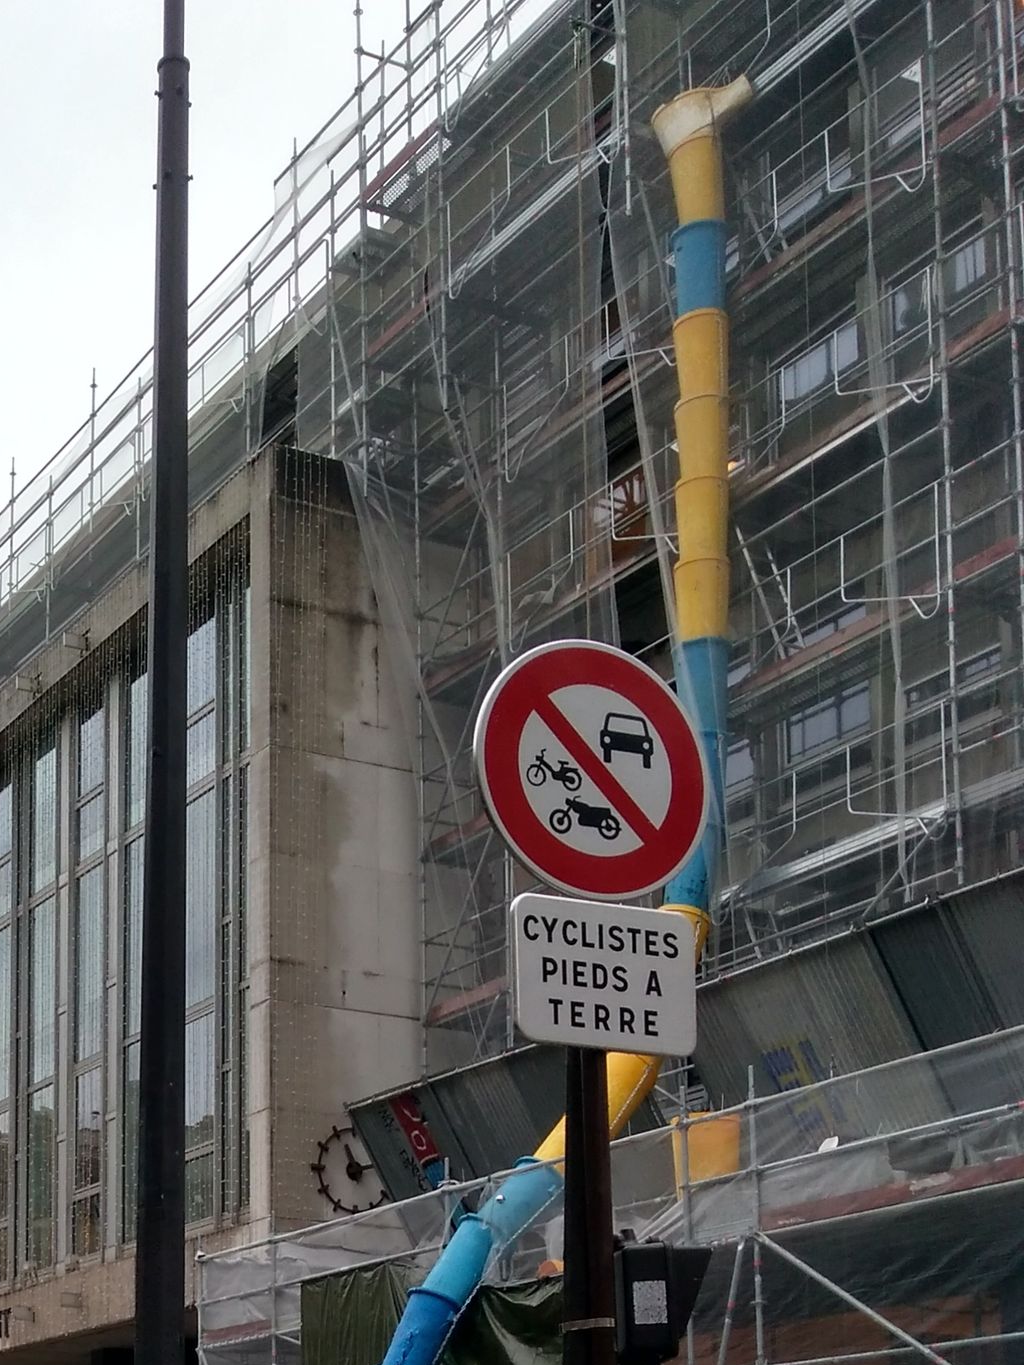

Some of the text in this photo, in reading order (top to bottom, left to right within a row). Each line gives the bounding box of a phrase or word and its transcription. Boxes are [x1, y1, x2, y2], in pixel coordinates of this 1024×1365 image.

[522, 914, 679, 959] CYCLISTES
[542, 956, 663, 997] PIEDS A
[548, 998, 660, 1037] TERRE
